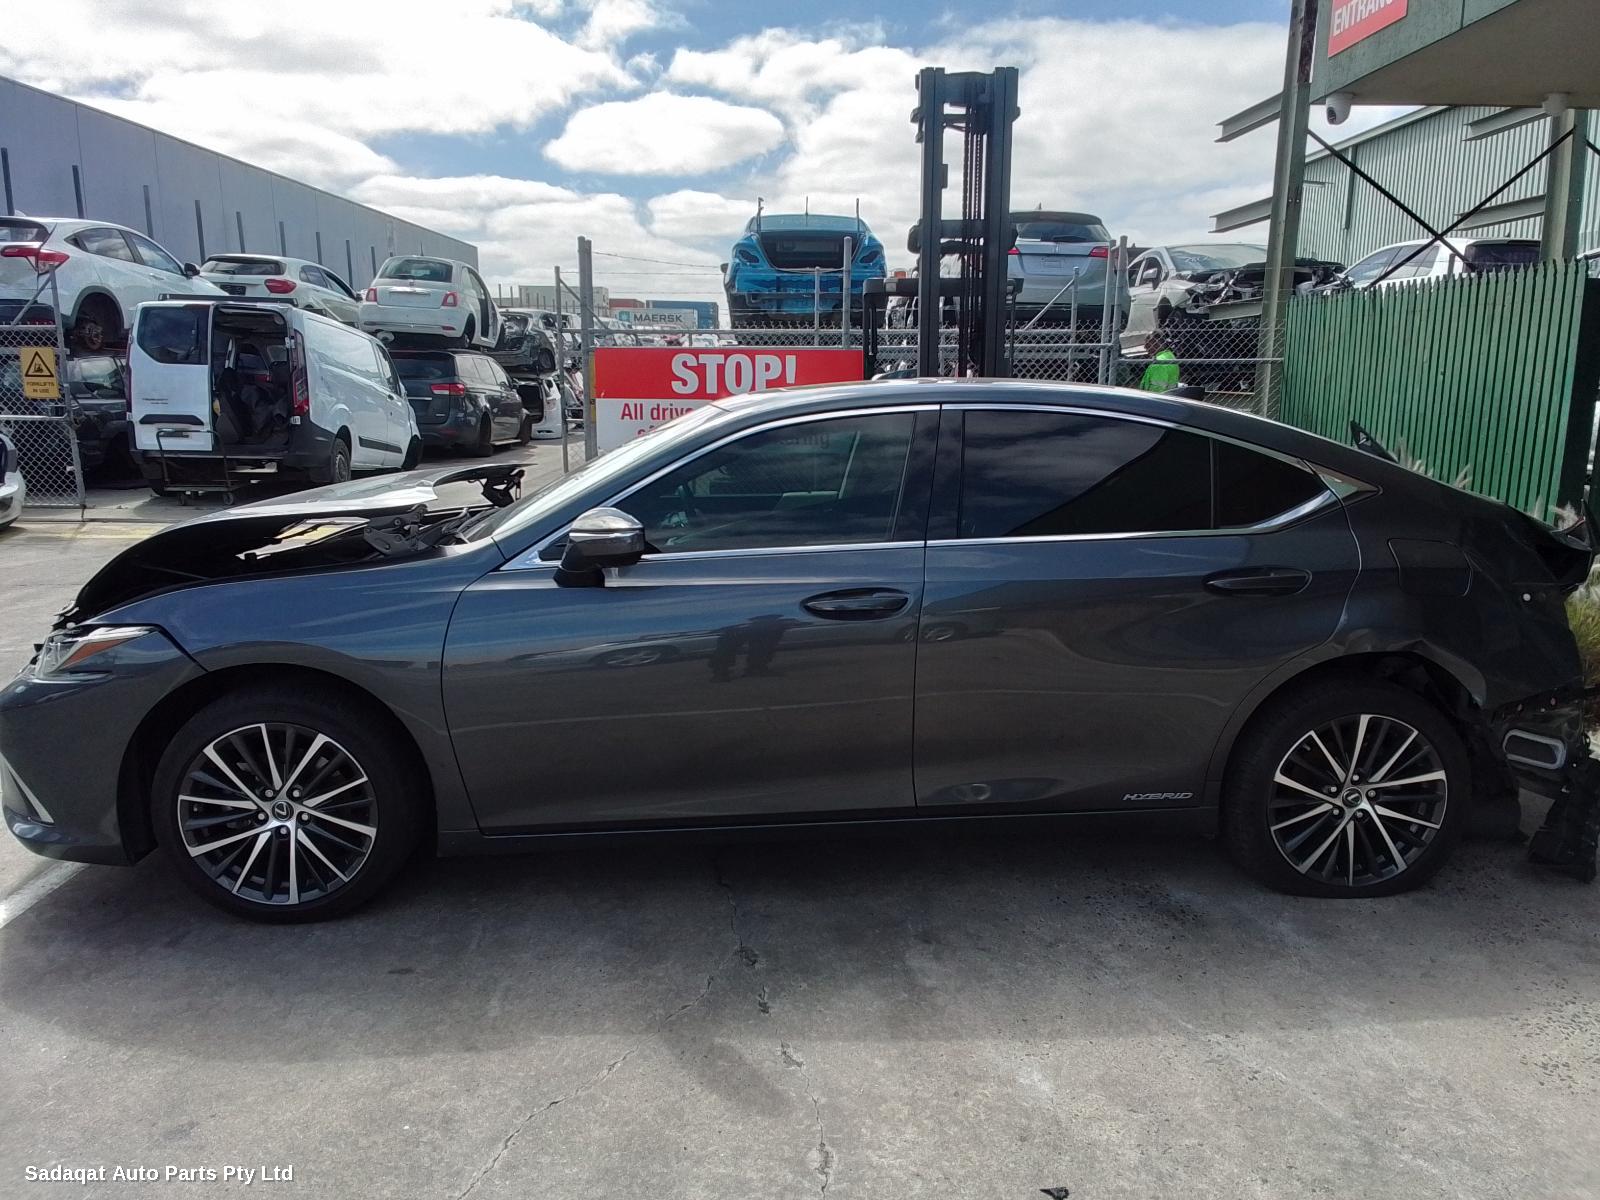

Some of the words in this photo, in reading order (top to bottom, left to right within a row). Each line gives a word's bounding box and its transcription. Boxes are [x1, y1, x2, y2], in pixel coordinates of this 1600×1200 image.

[1332, 0, 1393, 37] ENTRA
[633, 314, 683, 323] MAERSK
[671, 354, 797, 395] STOP!
[621, 403, 644, 420] All
[1122, 792, 1193, 801] HYBRID
